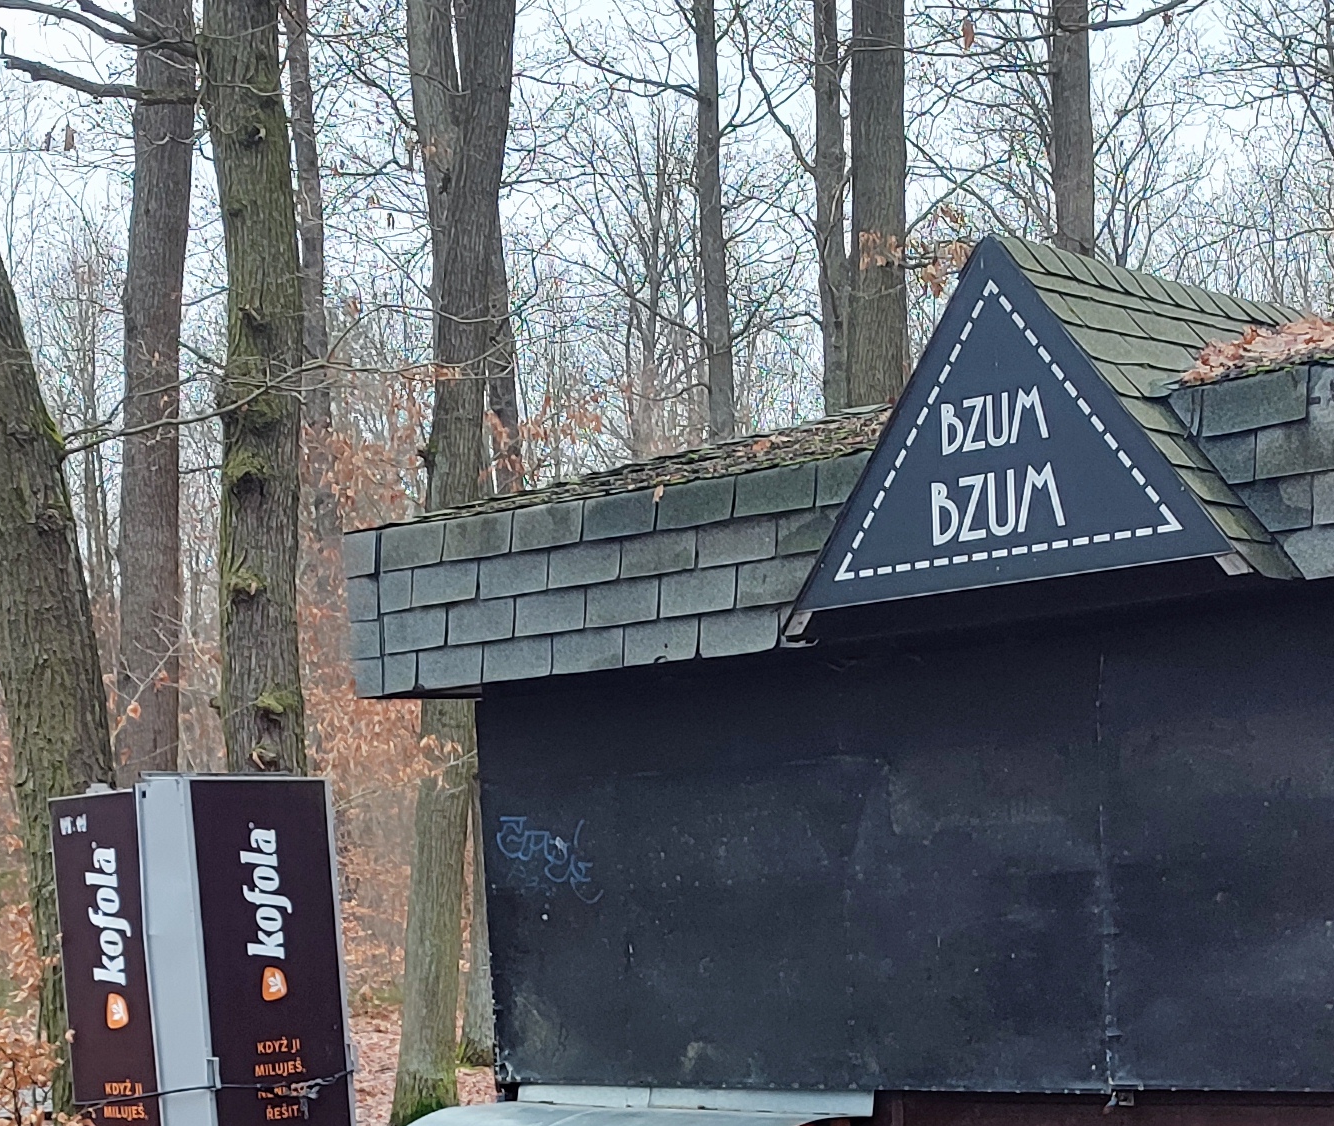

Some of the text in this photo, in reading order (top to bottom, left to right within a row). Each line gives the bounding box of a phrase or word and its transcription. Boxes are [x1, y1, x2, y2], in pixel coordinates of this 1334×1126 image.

[940, 385, 1050, 456] BZUM
[930, 461, 1066, 547] BZUM
[85, 847, 132, 986] kofola
[239, 828, 293, 960] kofola
[256, 1036, 301, 1055] KDYŽ JI
[104, 1078, 133, 1096] KDYŽ
